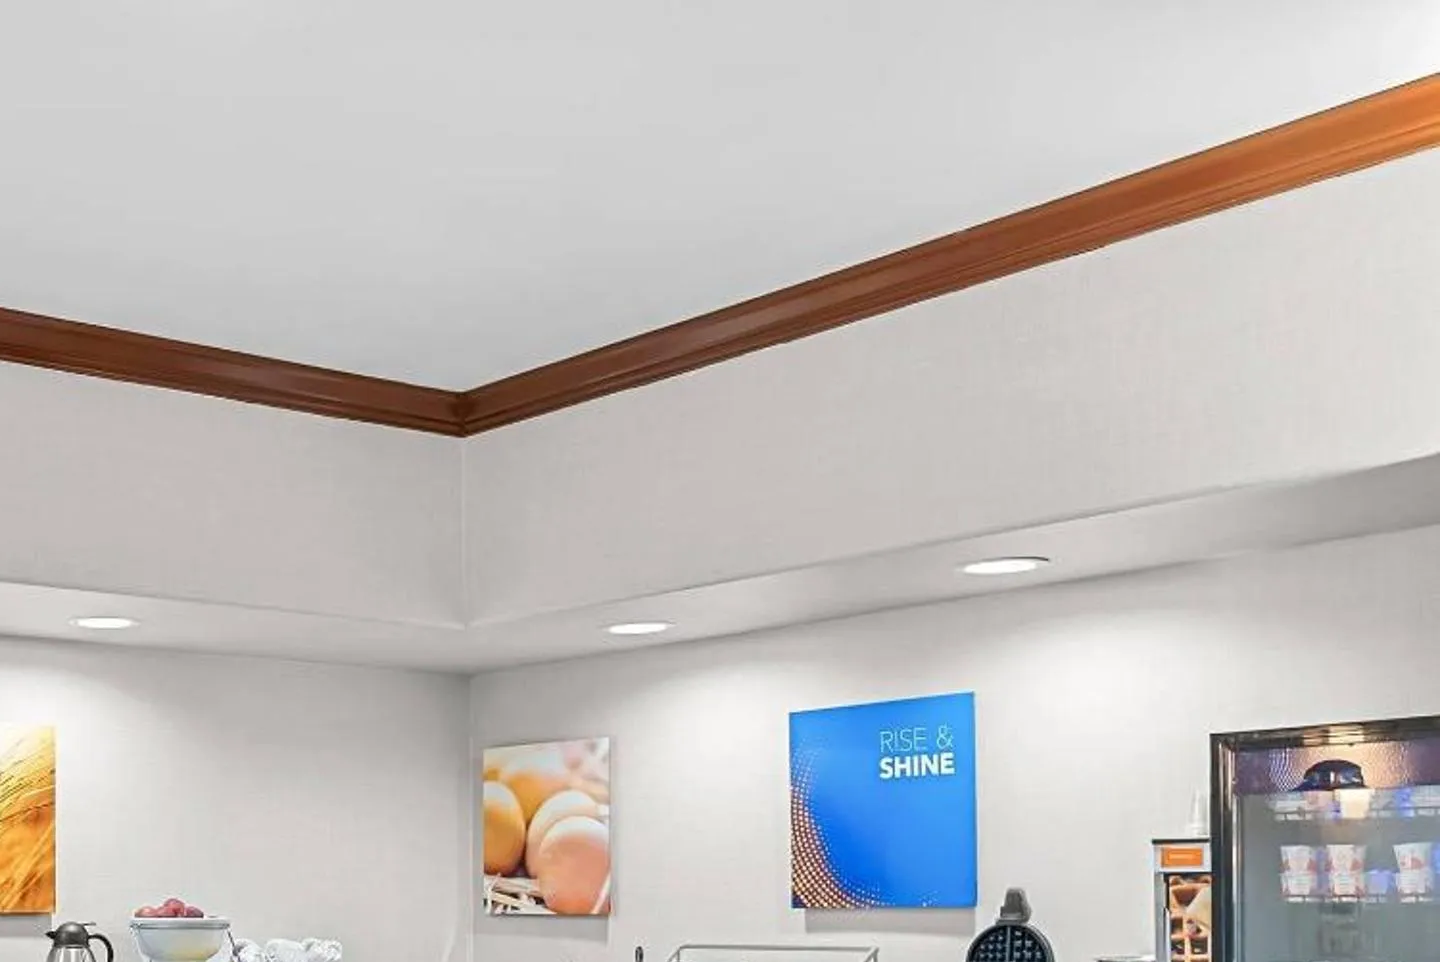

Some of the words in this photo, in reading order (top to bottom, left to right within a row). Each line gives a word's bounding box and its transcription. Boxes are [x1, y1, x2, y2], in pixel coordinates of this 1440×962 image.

[879, 727, 927, 753] RISE
[936, 724, 954, 750] &
[879, 752, 956, 779] SHINE
